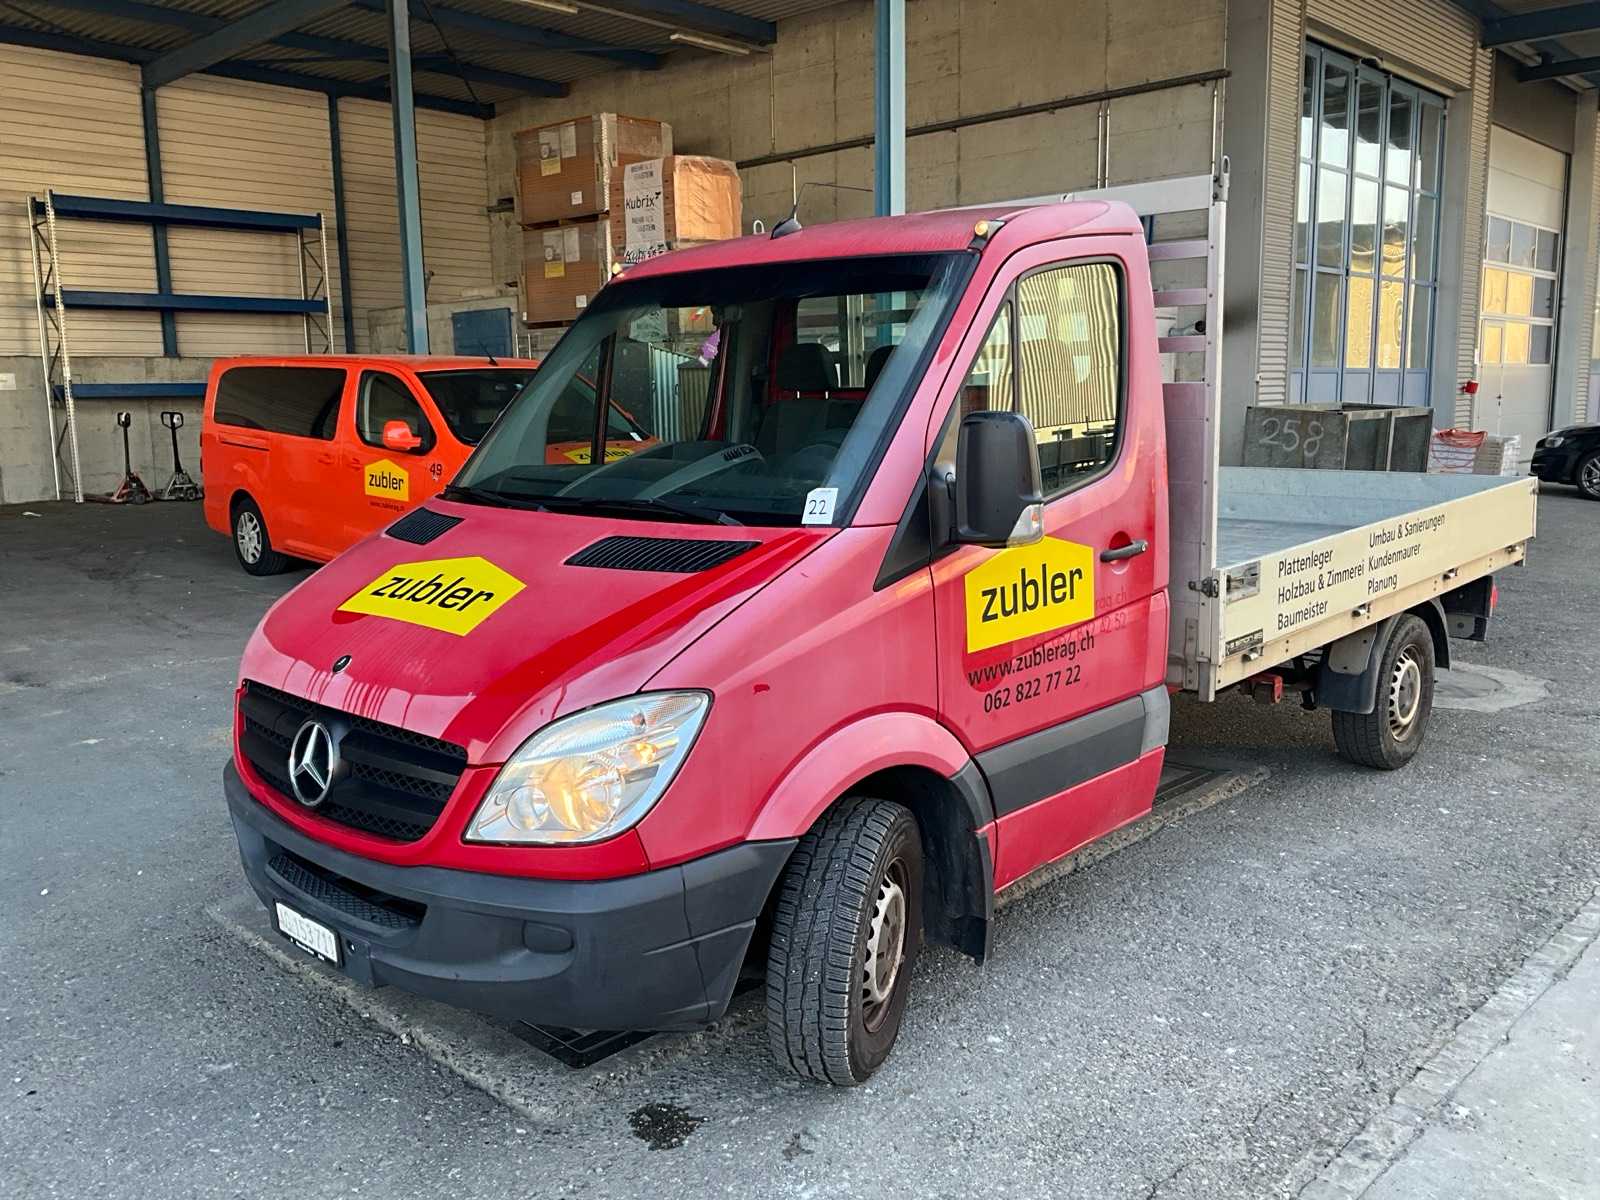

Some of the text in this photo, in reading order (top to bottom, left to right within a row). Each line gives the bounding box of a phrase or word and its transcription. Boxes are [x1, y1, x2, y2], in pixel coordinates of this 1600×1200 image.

[625, 194, 655, 209] Kubrix
[1259, 417, 1324, 457] 258
[369, 471, 404, 491] zubler
[430, 463, 442, 476] 49
[808, 499, 827, 515] 22
[1369, 514, 1445, 548] Umbau & Sanierungen
[1278, 549, 1333, 578] Plattenleger
[1368, 543, 1421, 571] Kundenmaurer
[371, 574, 495, 611] zubler
[981, 563, 1083, 623] zubler
[1278, 560, 1365, 604] Holzbau & Zimmerei
[1368, 573, 1397, 595] Planung
[1277, 600, 1328, 631] Baumeister
[968, 631, 1095, 686] www.zublerag.ch
[984, 665, 1081, 713] 062 822 77 22
